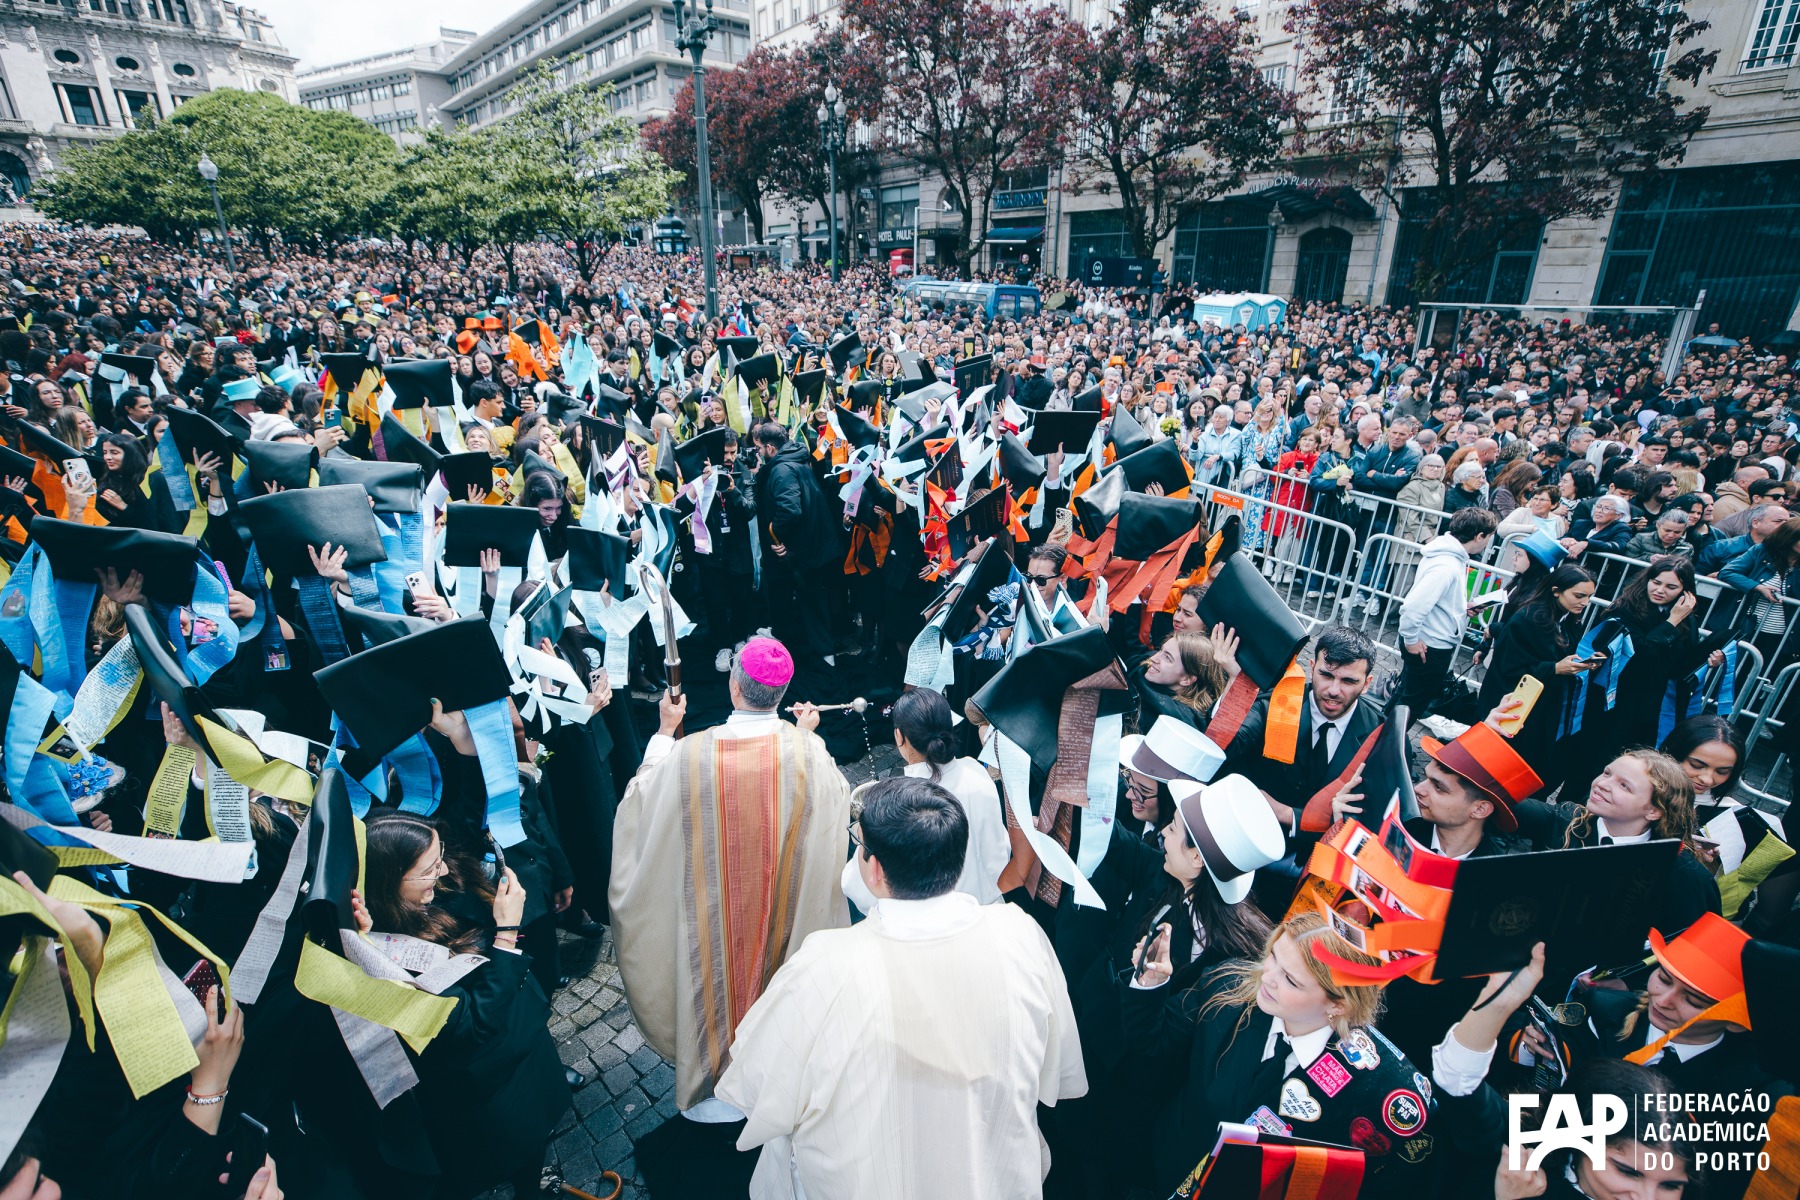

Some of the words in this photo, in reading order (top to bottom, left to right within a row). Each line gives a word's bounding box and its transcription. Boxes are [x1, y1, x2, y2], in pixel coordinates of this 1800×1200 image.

[878, 231, 893, 242] HOTEL
[1314, 1065, 1336, 1090] CHATA
[1327, 1059, 1345, 1078] MÃE
[1397, 1096, 1419, 1117] SUPER
[1397, 1106, 1411, 1120] PAI
